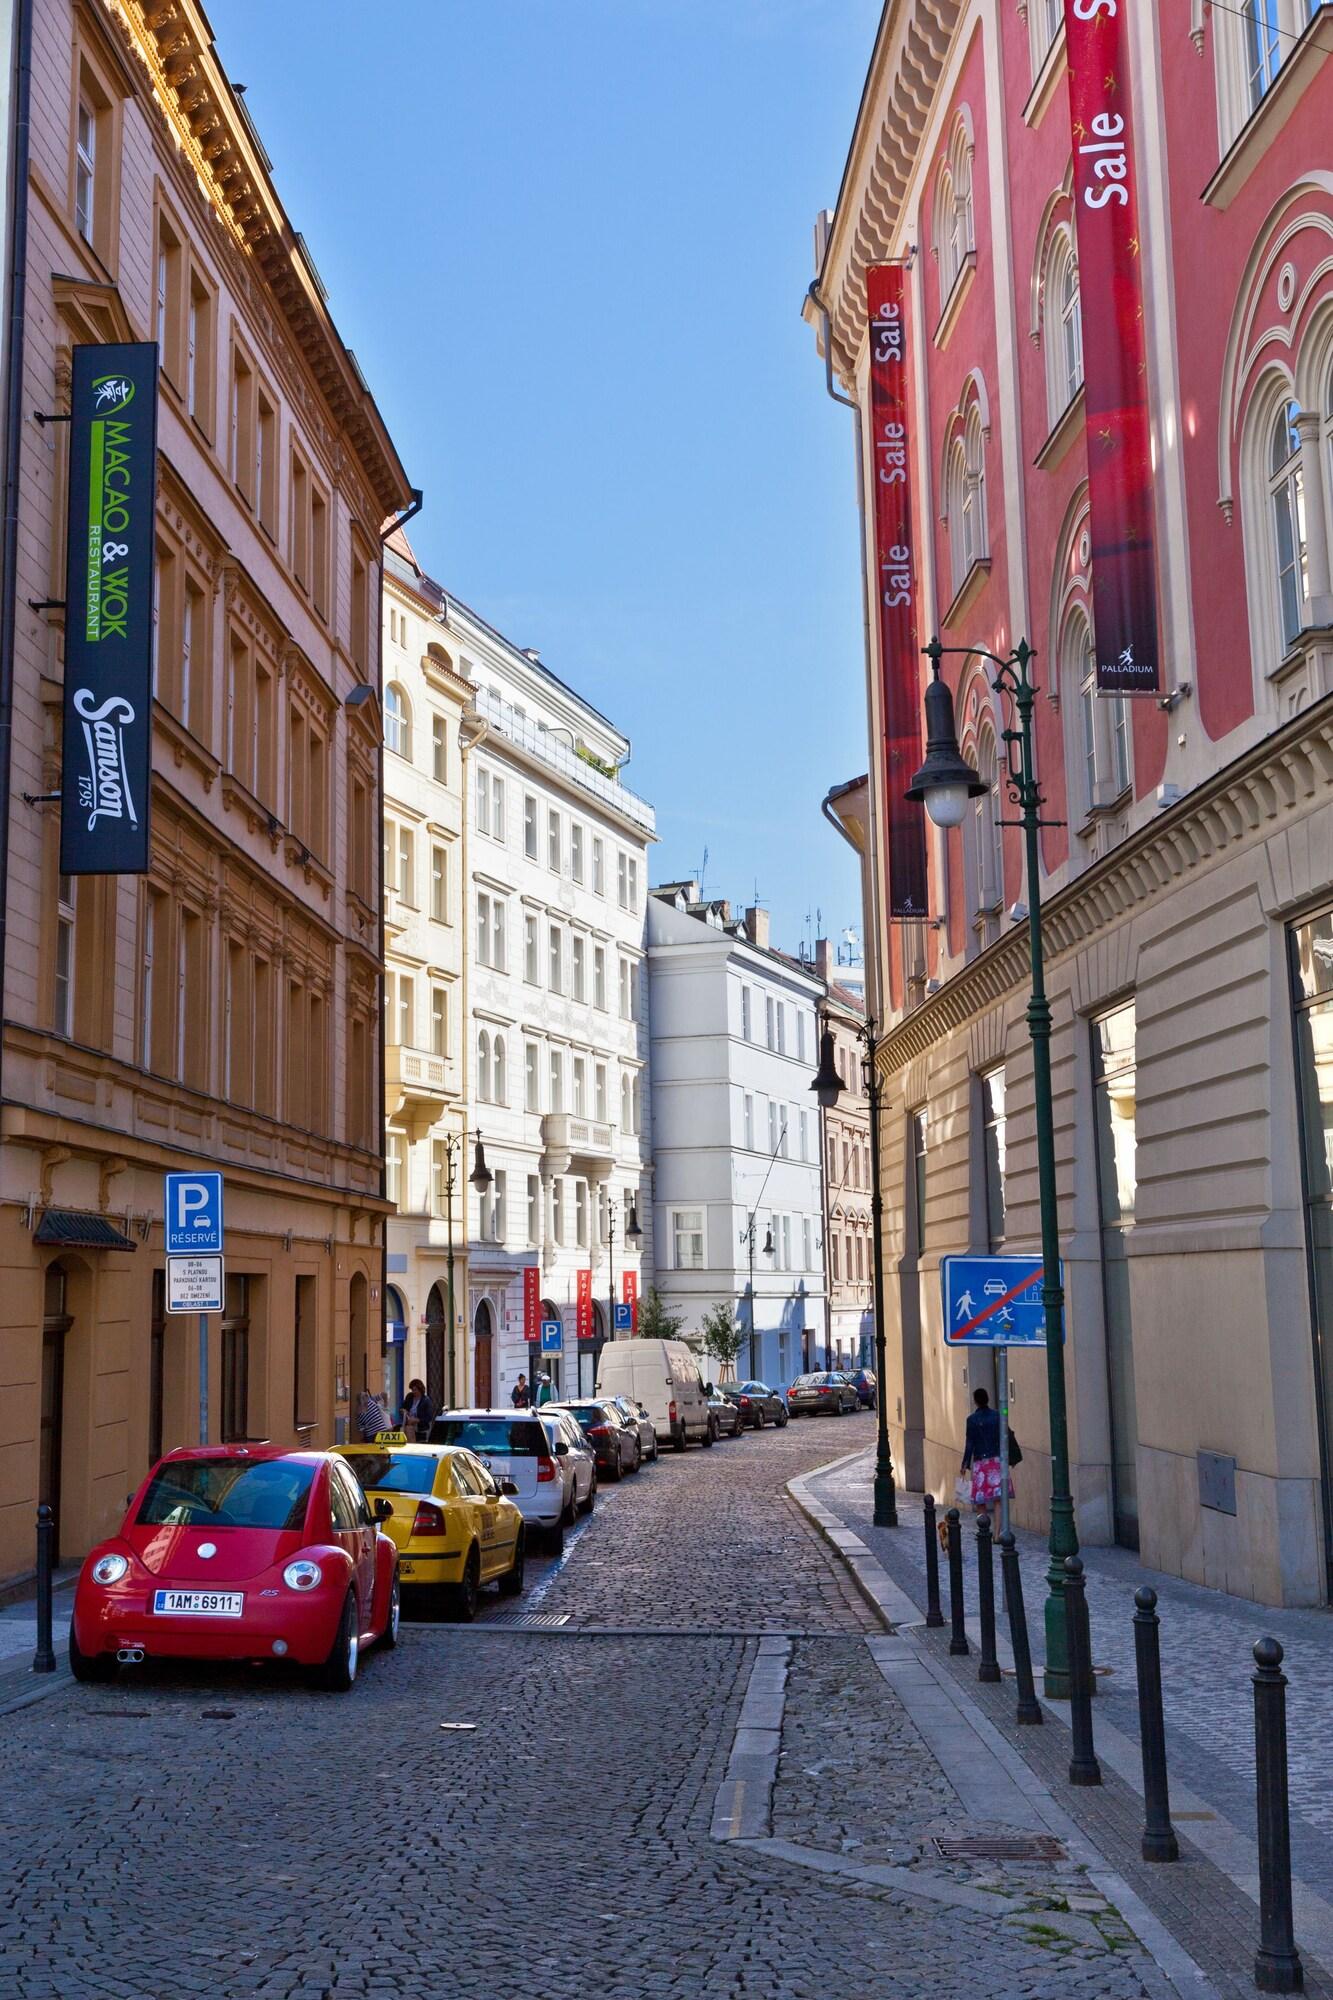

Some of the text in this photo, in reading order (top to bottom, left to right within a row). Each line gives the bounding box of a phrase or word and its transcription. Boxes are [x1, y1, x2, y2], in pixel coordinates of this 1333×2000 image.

[1079, 112, 1129, 209] Sale
[872, 302, 901, 362] Sale
[877, 422, 907, 484] Sale
[101, 421, 132, 640] MACAO & WOK
[87, 525, 101, 639] RESTAURANT
[882, 544, 912, 607] Sale
[1101, 665, 1153, 673] PALLADIUM
[73, 688, 136, 832] Samson
[78, 775, 93, 808] 1795
[178, 1183, 209, 1228] P
[171, 1231, 217, 1244] RÉSERVÉ
[545, 1324, 558, 1343] P
[617, 1306, 628, 1321] P
[380, 1433, 400, 1441] TAXI
[169, 1594, 233, 1610] 1AM 6911
